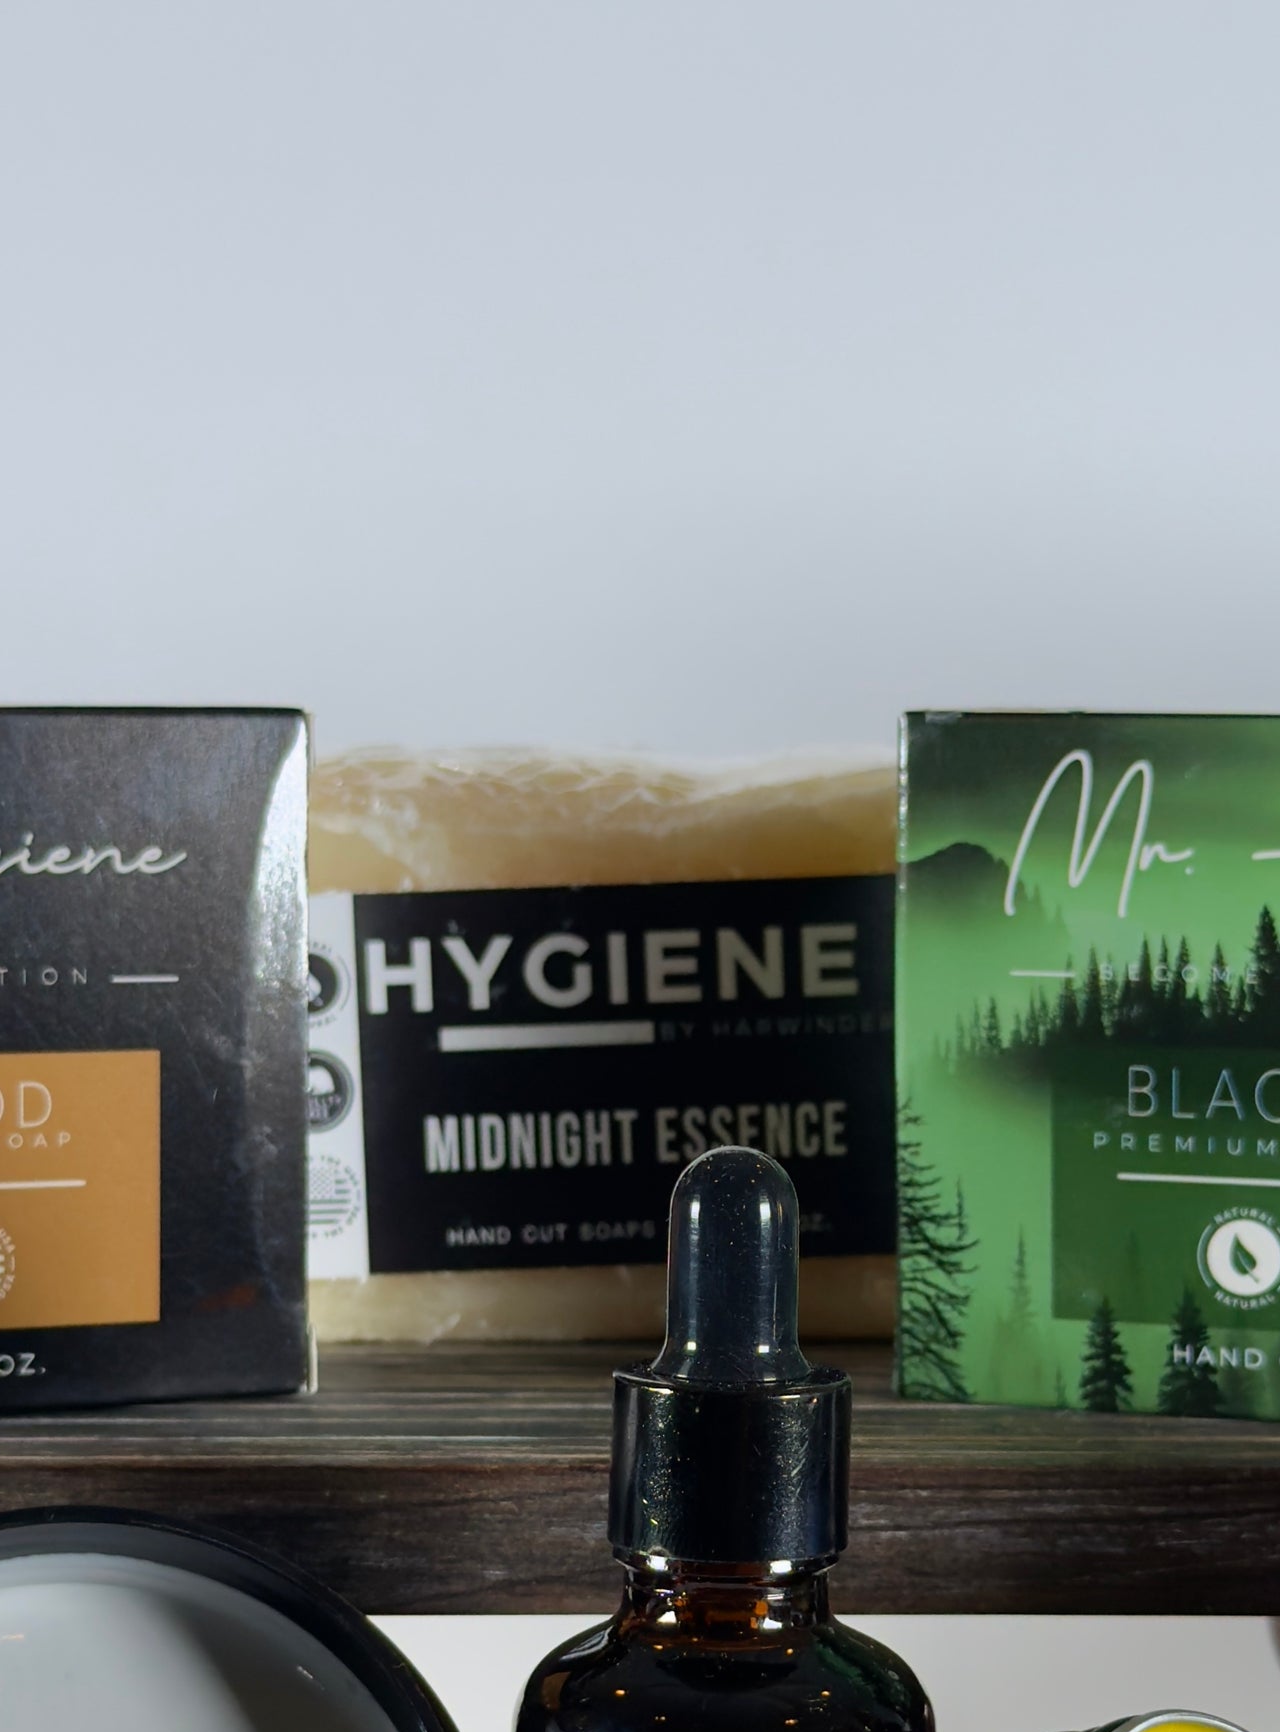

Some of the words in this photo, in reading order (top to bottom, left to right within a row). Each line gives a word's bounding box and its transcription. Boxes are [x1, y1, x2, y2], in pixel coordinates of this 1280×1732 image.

[1003, 749, 1195, 918] Mr.
[363, 922, 860, 1016] HYGIENE
[1099, 963, 1259, 985] BECOME
[423, 1109, 639, 1174] MIDNIGHT
[656, 1101, 849, 1164] ESSENCE
[1092, 1131, 1279, 1157] PREMIUM
[1213, 1206, 1276, 1225] NATURAL
[445, 1225, 512, 1247] HAND
[523, 1222, 568, 1244] CUT
[580, 1219, 656, 1242] SOAPS
[1213, 1289, 1276, 1310] NATURAL
[1171, 1343, 1266, 1370] HAND
